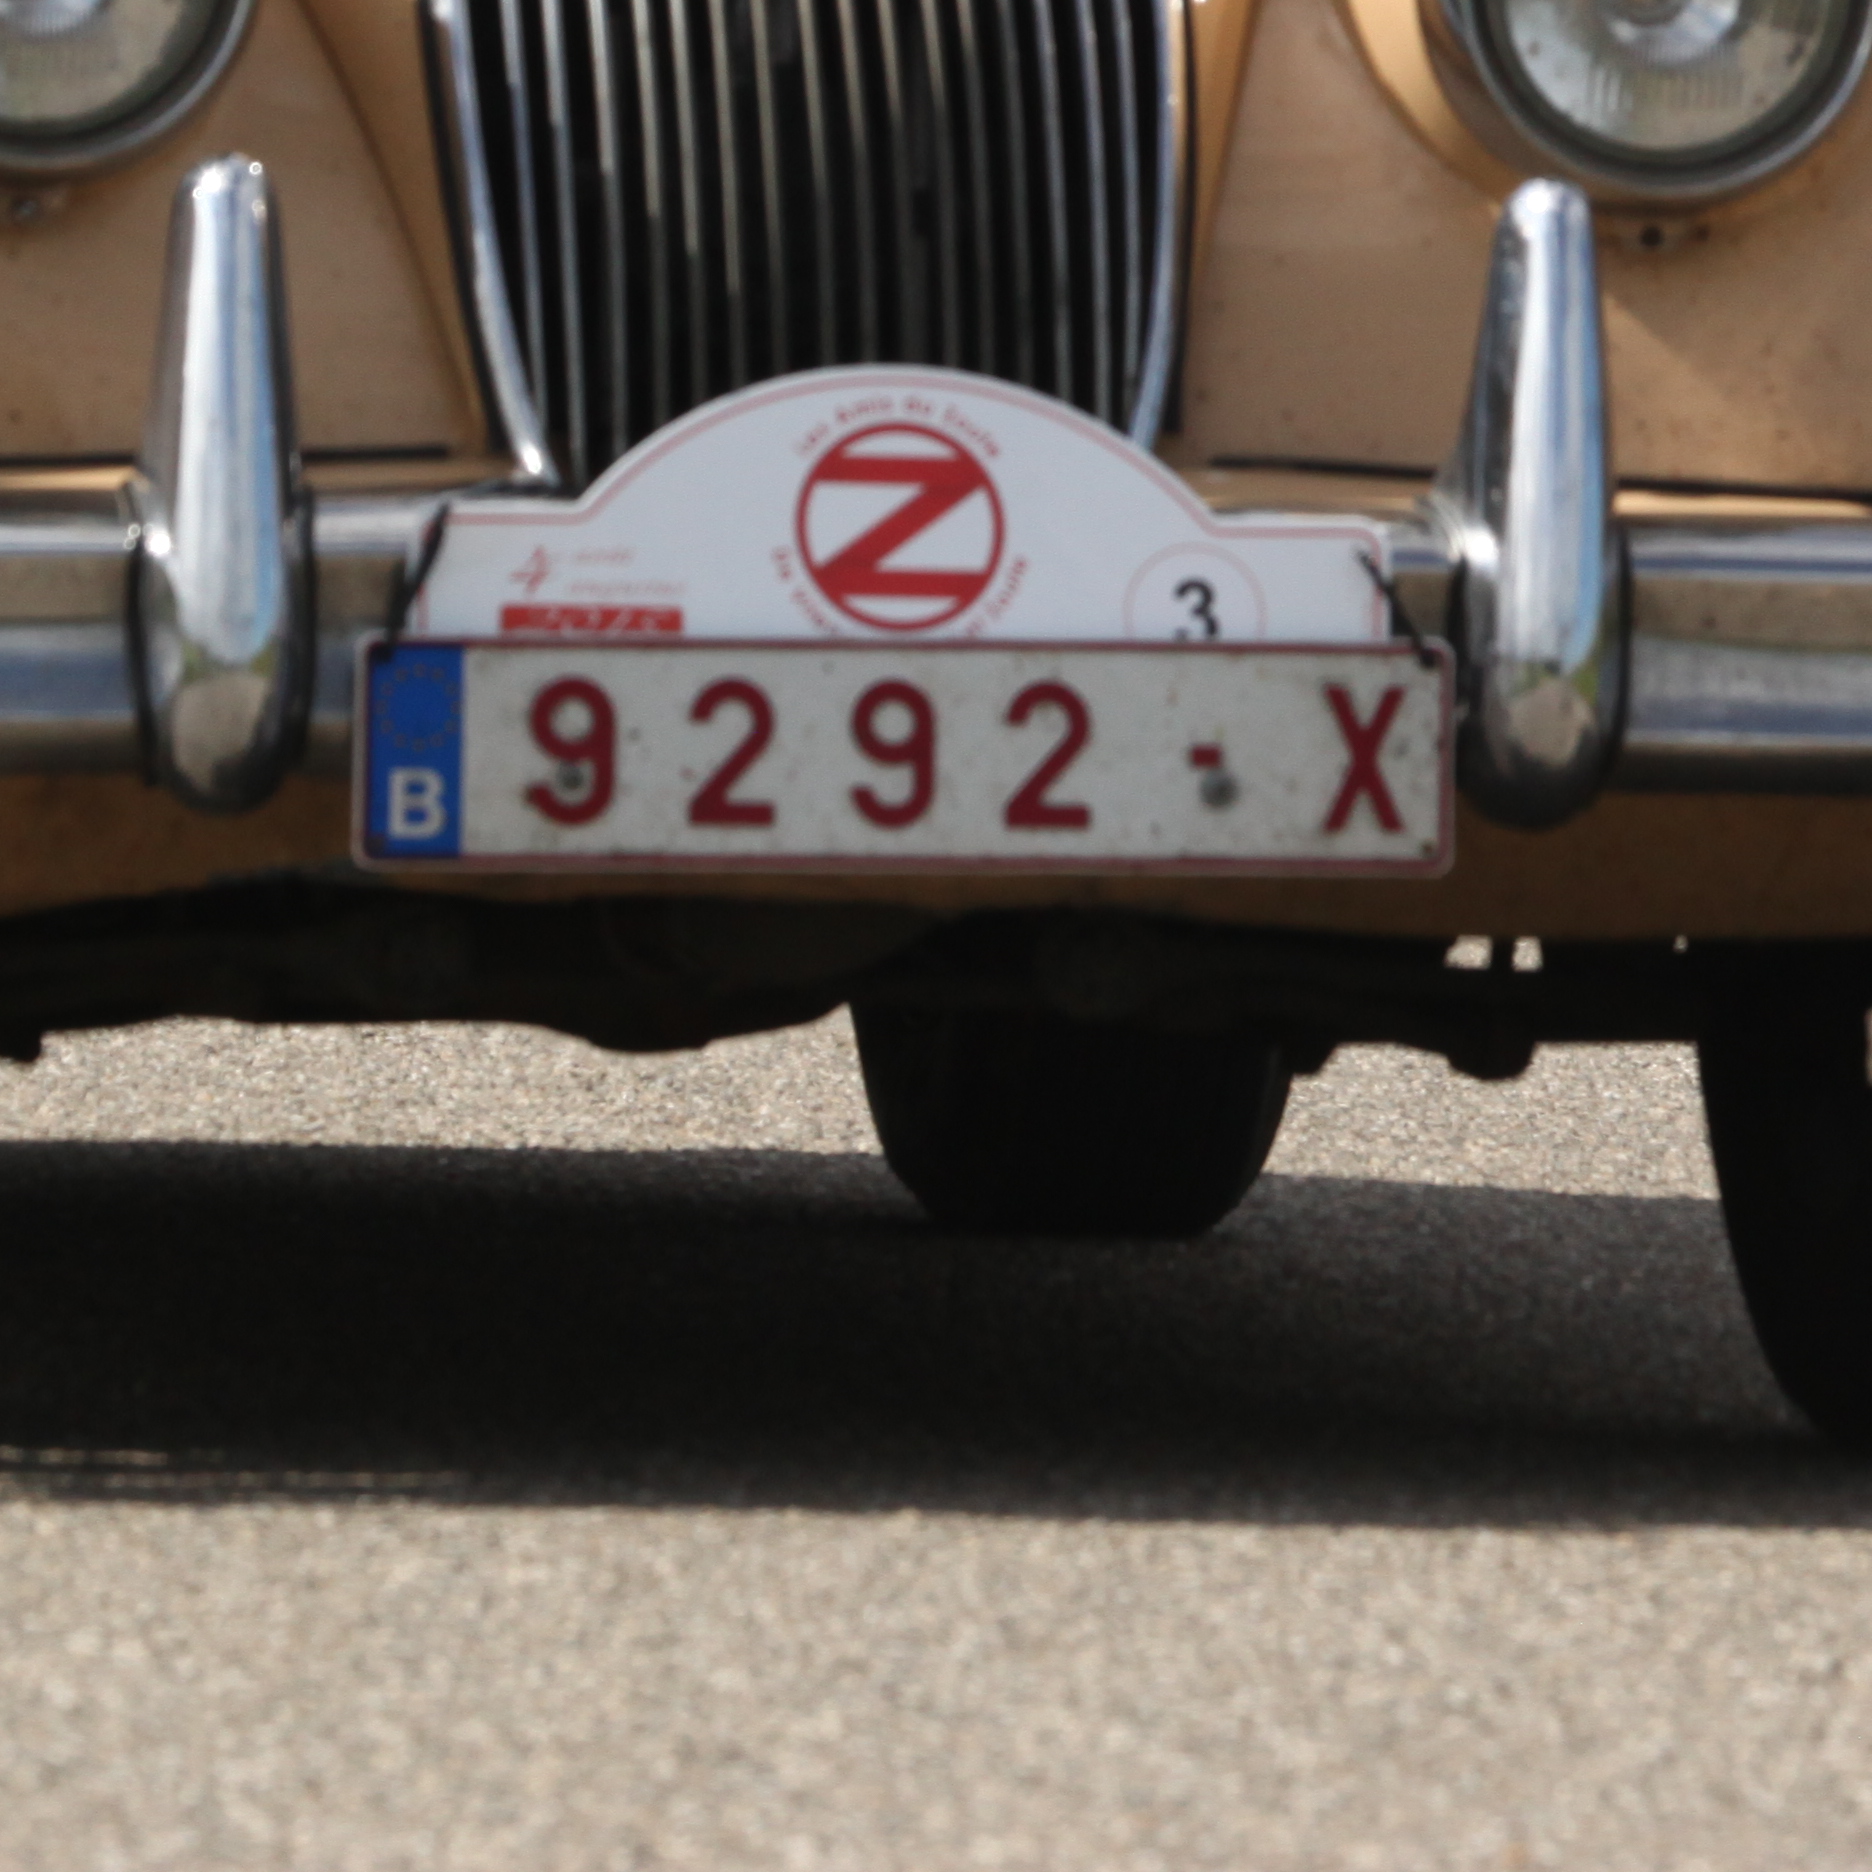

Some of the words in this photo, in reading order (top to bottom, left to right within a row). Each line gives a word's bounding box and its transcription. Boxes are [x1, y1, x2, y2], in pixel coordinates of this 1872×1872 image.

[808, 456, 990, 596] Z
[1173, 578, 1220, 642] 3
[389, 767, 447, 841] B
